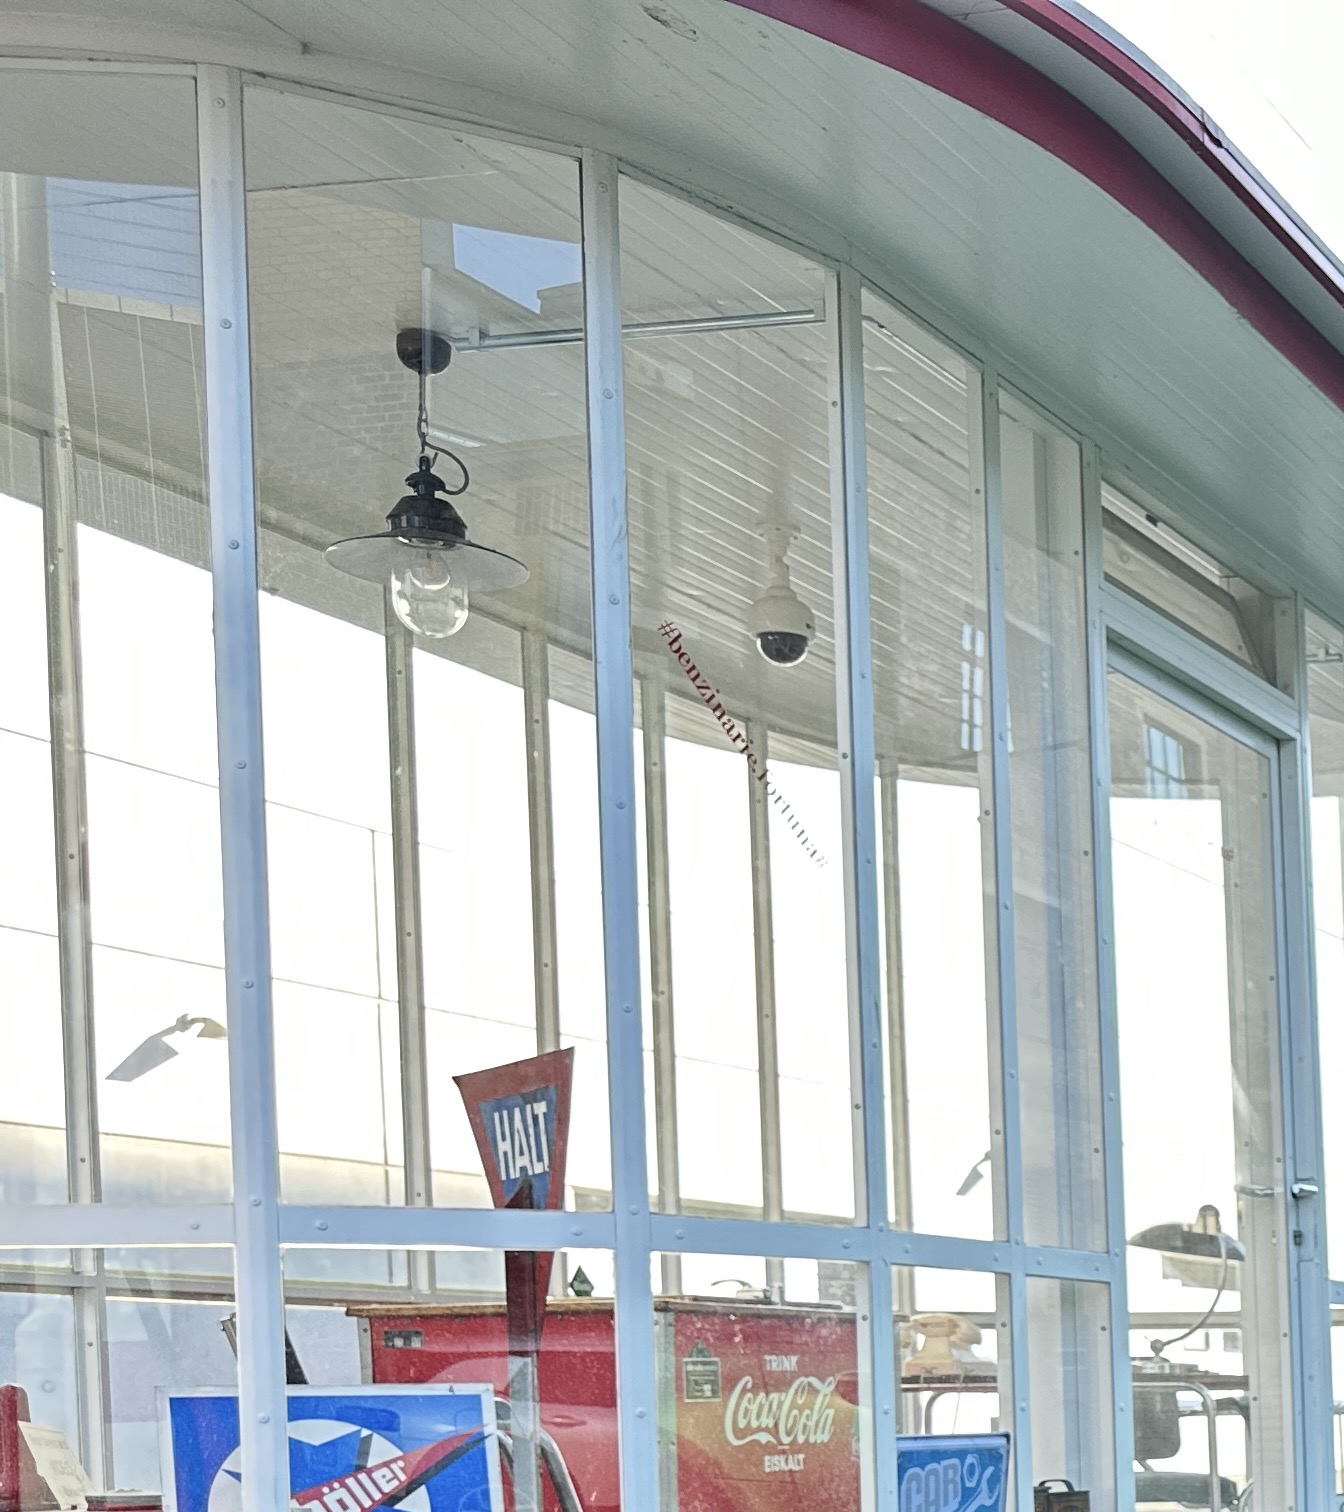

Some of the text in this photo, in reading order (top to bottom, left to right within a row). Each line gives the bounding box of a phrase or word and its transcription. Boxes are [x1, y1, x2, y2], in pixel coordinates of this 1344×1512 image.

[493, 1100, 550, 1180] HALT
[763, 1355, 800, 1372] TRINK
[763, 1453, 805, 1473] EISKALT
